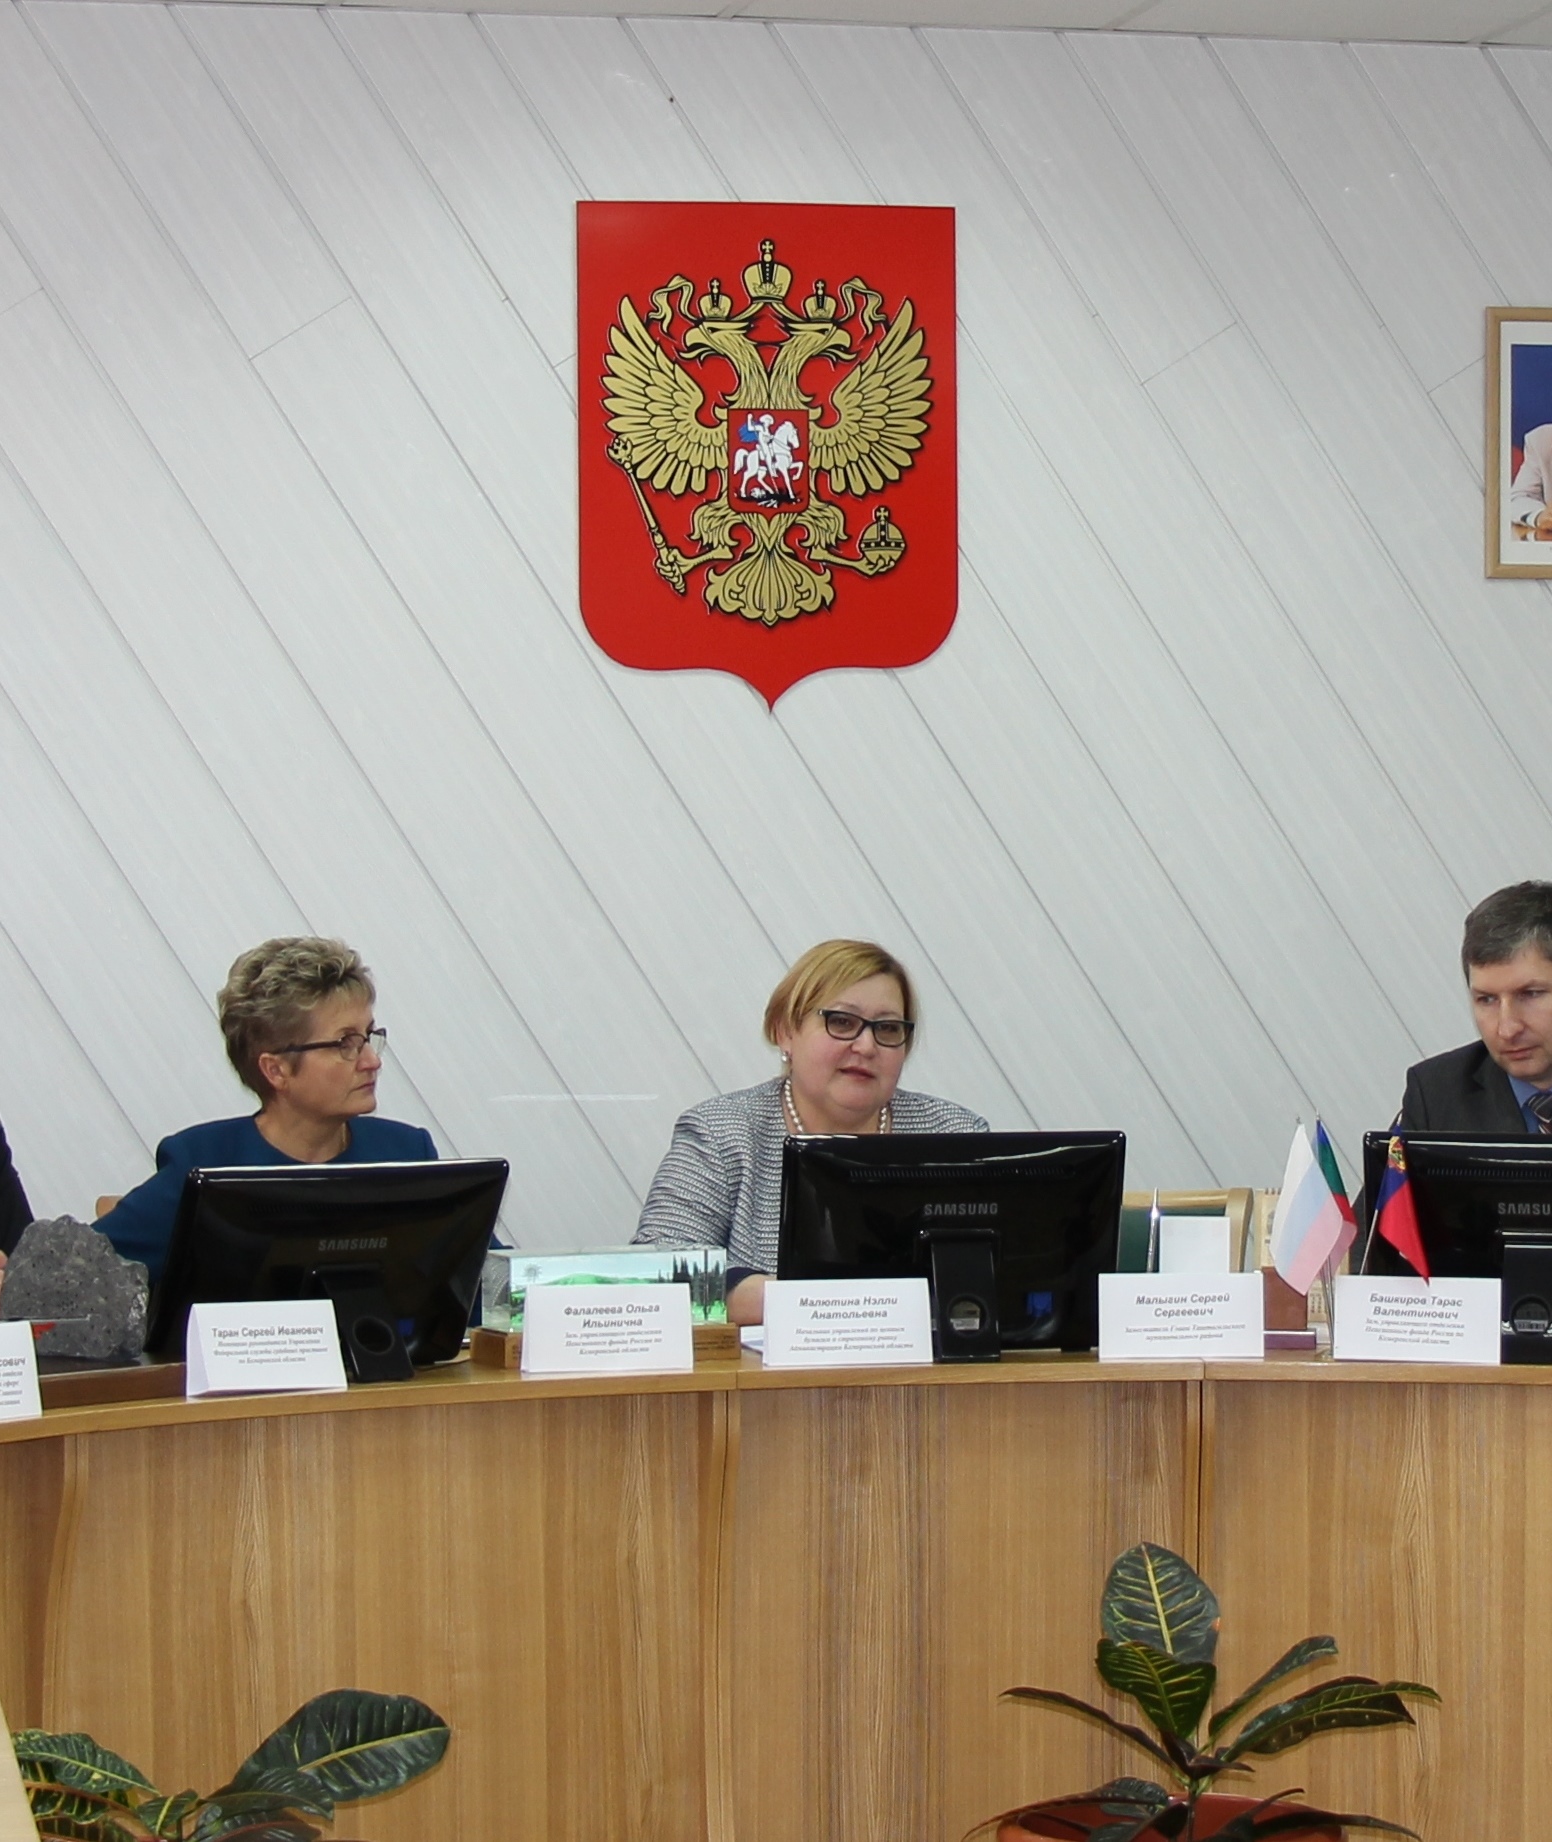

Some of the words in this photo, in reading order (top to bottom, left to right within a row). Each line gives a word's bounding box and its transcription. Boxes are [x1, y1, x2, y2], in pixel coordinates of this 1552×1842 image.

[924, 1203, 998, 1216] SAMSUNG
[318, 1237, 388, 1251] SAMSUNG
[799, 1297, 860, 1307] Малютина
[863, 1296, 898, 1305] Нэлли
[1136, 1295, 1187, 1305] Малыгин
[1190, 1293, 1230, 1305] Сергей
[1370, 1293, 1427, 1306] Башкиров
[1430, 1296, 1463, 1307] Тарас
[564, 1306, 623, 1316] Фалалеева
[626, 1304, 660, 1314] Ольга
[810, 1310, 888, 1320] Анатольевна
[1154, 1307, 1214, 1318] Сергеевич
[1373, 1306, 1459, 1320] Валентинович
[582, 1318, 643, 1328] Ильинична
[212, 1328, 239, 1338] Таран
[242, 1327, 275, 1338] Сергей
[278, 1326, 323, 1335] Иванович
